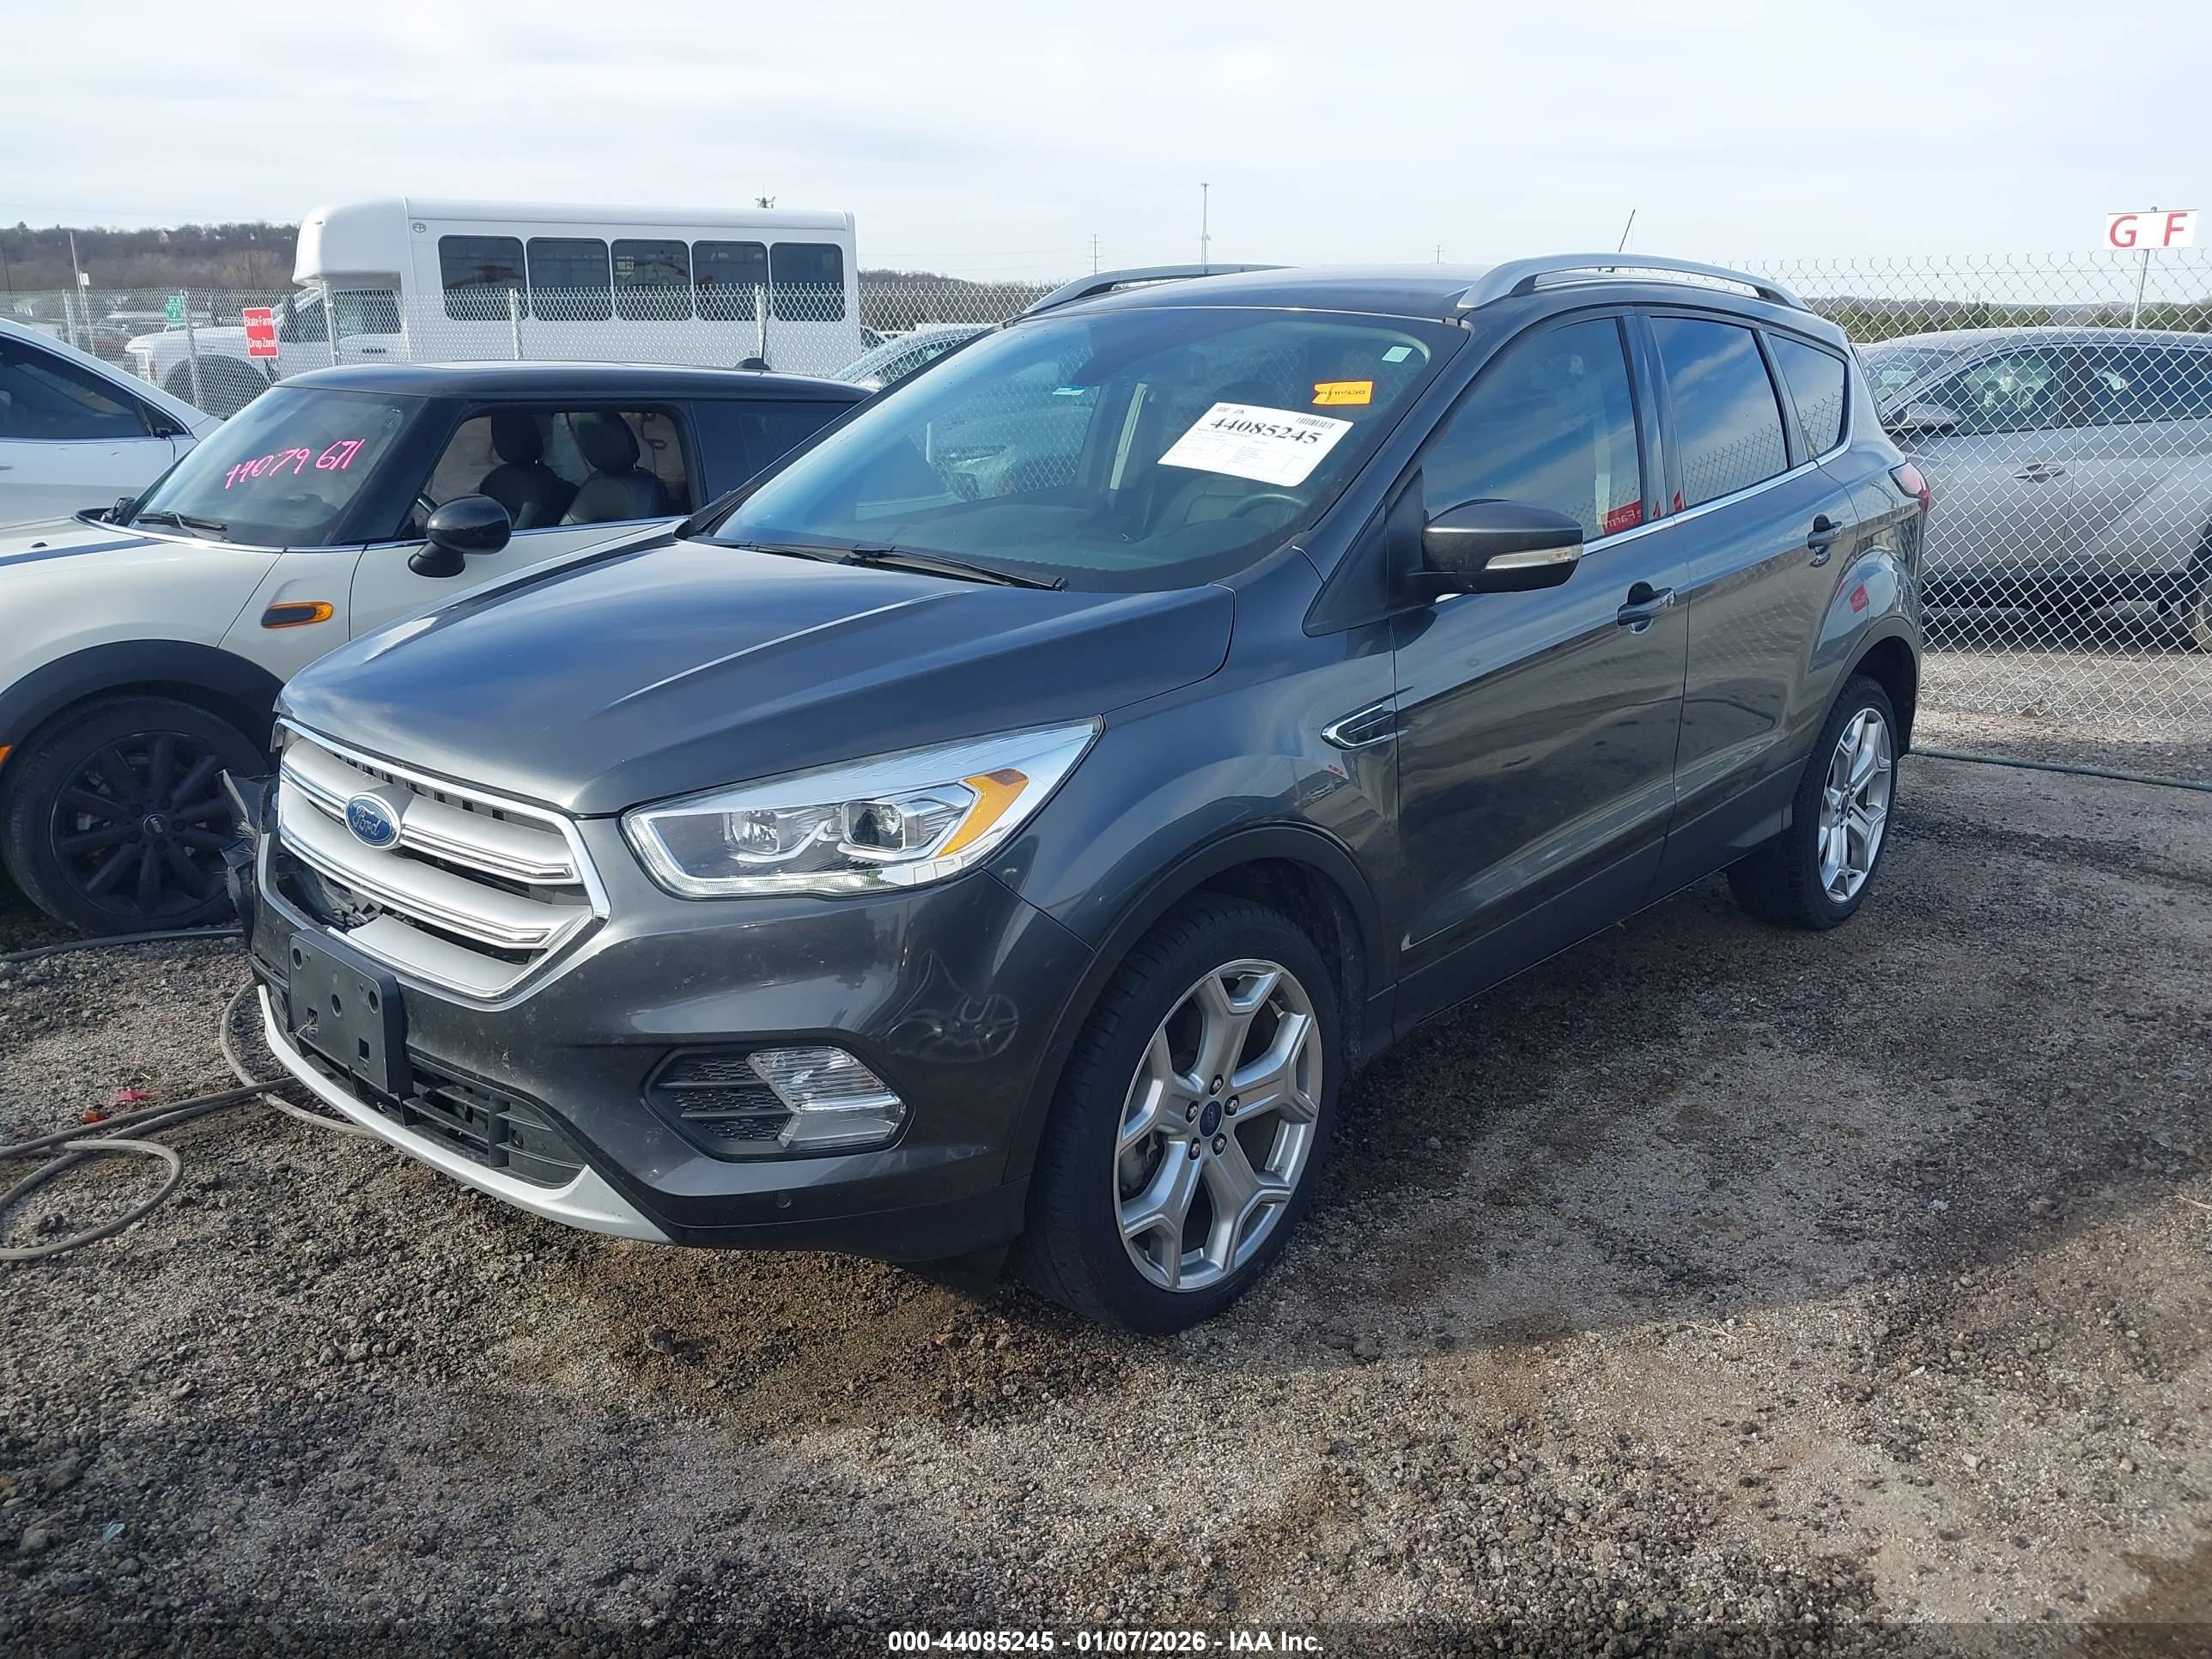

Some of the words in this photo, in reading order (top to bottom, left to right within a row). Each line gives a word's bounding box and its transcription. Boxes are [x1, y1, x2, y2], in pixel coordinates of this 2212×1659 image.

[2110, 215, 2138, 247] G
[2163, 212, 2188, 246] F
[245, 315, 258, 326] State
[258, 315, 273, 326] Farm
[248, 337, 262, 349] Drop
[262, 337, 276, 348] Zone
[1209, 417, 1323, 445] 44085245
[352, 805, 381, 836] Ford
